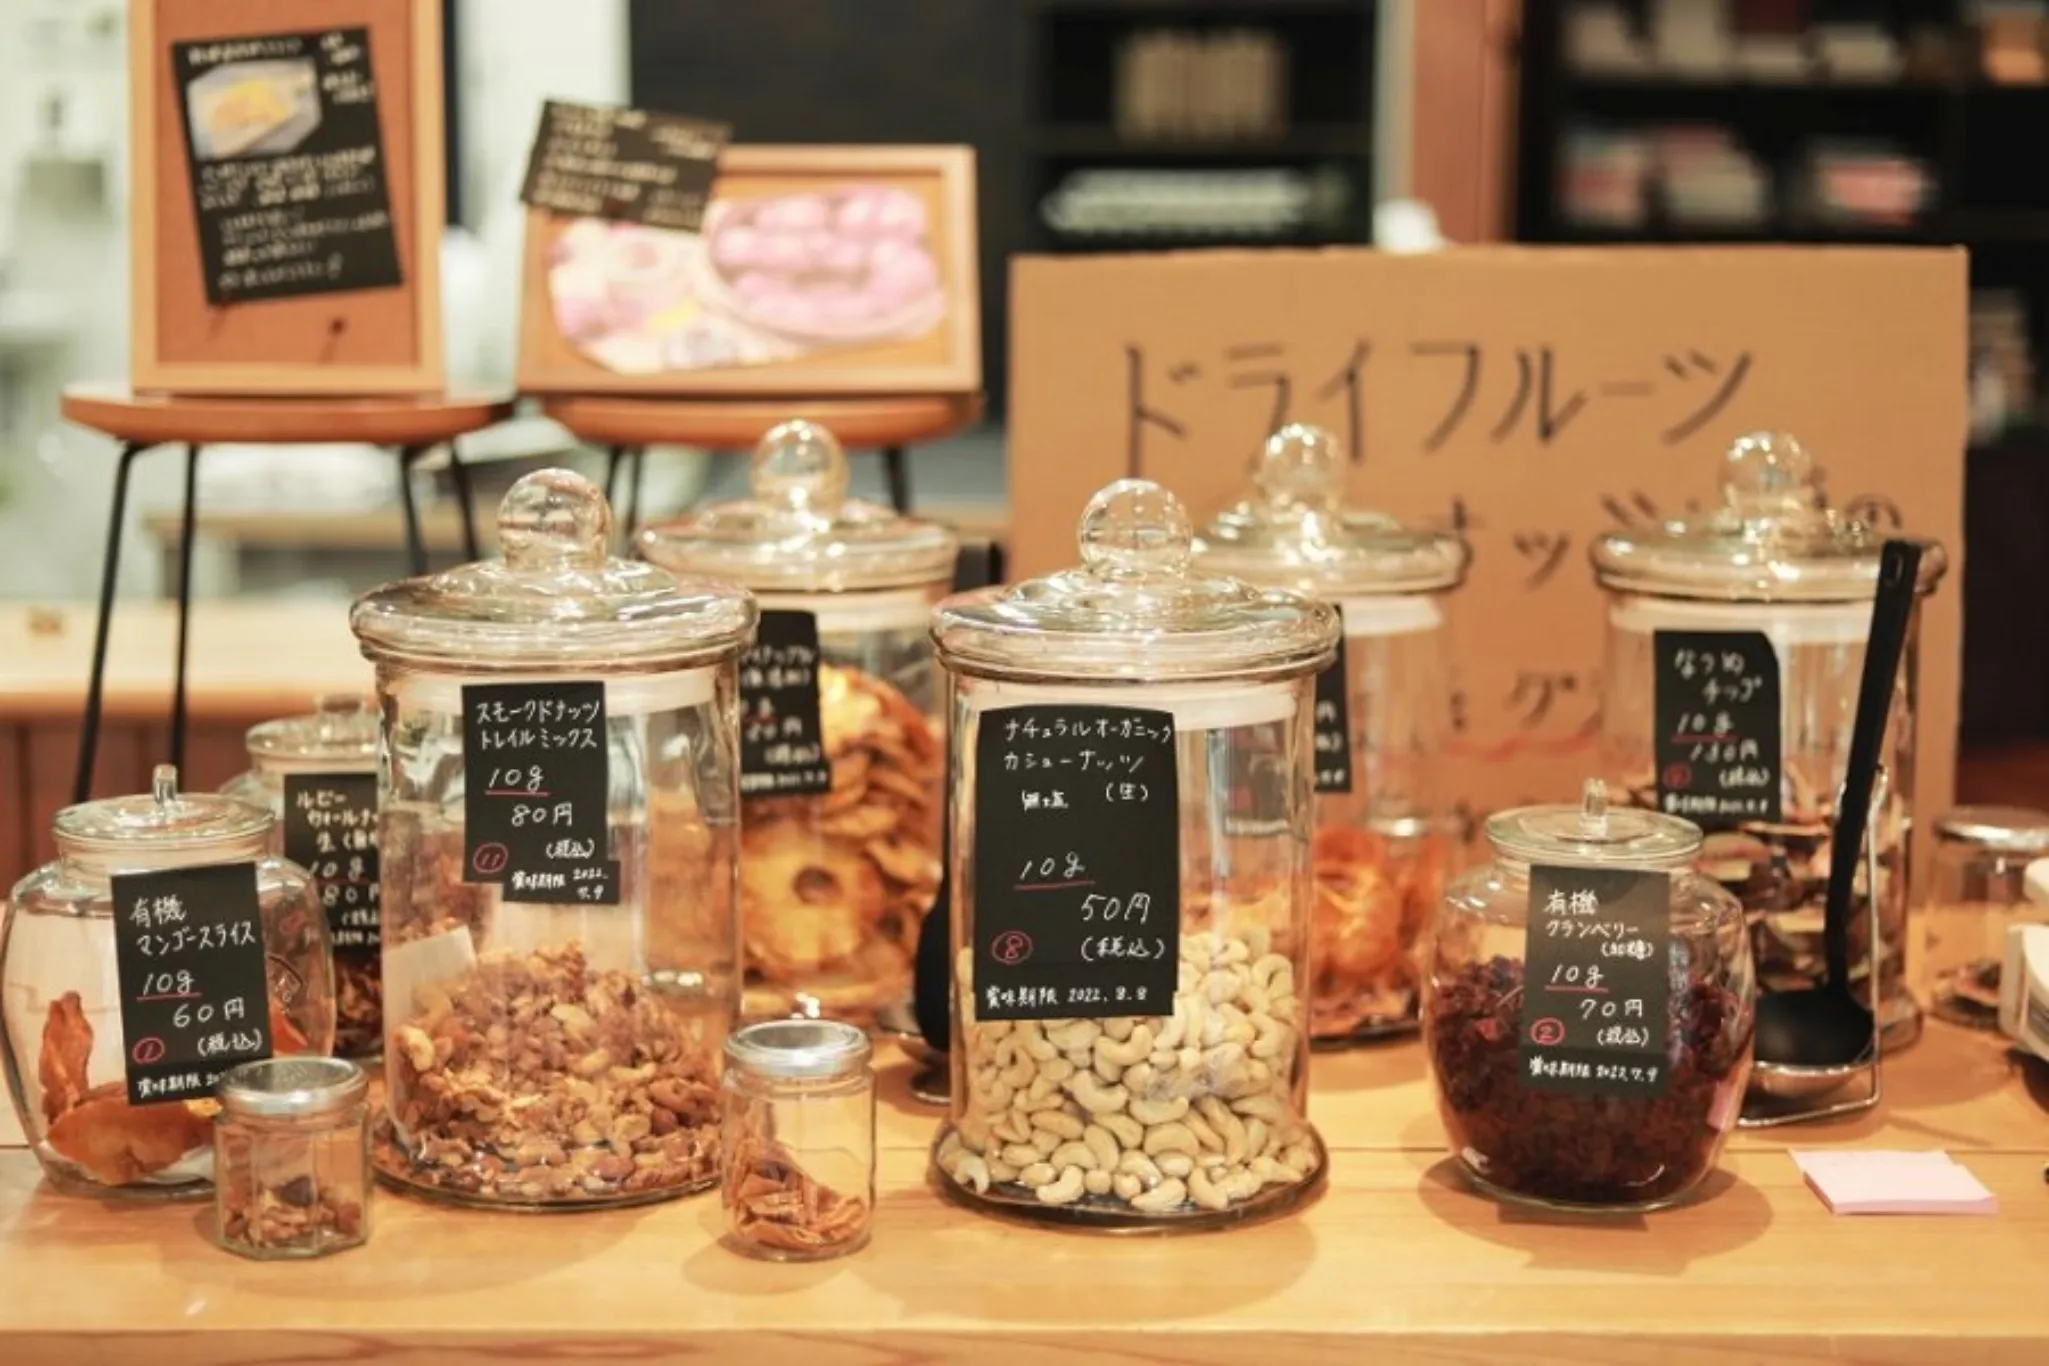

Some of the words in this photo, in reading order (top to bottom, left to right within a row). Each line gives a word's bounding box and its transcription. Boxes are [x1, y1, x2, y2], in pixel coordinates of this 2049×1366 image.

[1124, 340, 1751, 480] ドライフルーツ
[1674, 648, 1745, 680] なつめ
[481, 728, 598, 749] トレイルミックス
[1004, 749, 1145, 773] カシューナッツ
[489, 764, 544, 793] 10g
[296, 789, 347, 809] ルビー
[1105, 782, 1149, 802] (生)
[511, 802, 573, 827] 80円
[1019, 851, 1086, 879] 10g
[130, 894, 187, 928] 有機
[1081, 892, 1151, 924] 50円
[1543, 888, 1599, 916] 有機
[136, 921, 256, 956] マンゴースライス
[1546, 919, 1640, 939] クランベリー
[1081, 935, 1165, 962] (税込)
[143, 969, 195, 996] 10g
[1550, 964, 1604, 989] 10g
[986, 985, 1059, 1010] 賞味期限
[1579, 998, 1644, 1020] 70円
[173, 997, 244, 1028] 60円
[197, 1029, 263, 1056] (税込)
[1596, 1025, 1650, 1048] (税込)
[1529, 1055, 1592, 1078] 賞味期限
[137, 1072, 201, 1098] 賞味期限
